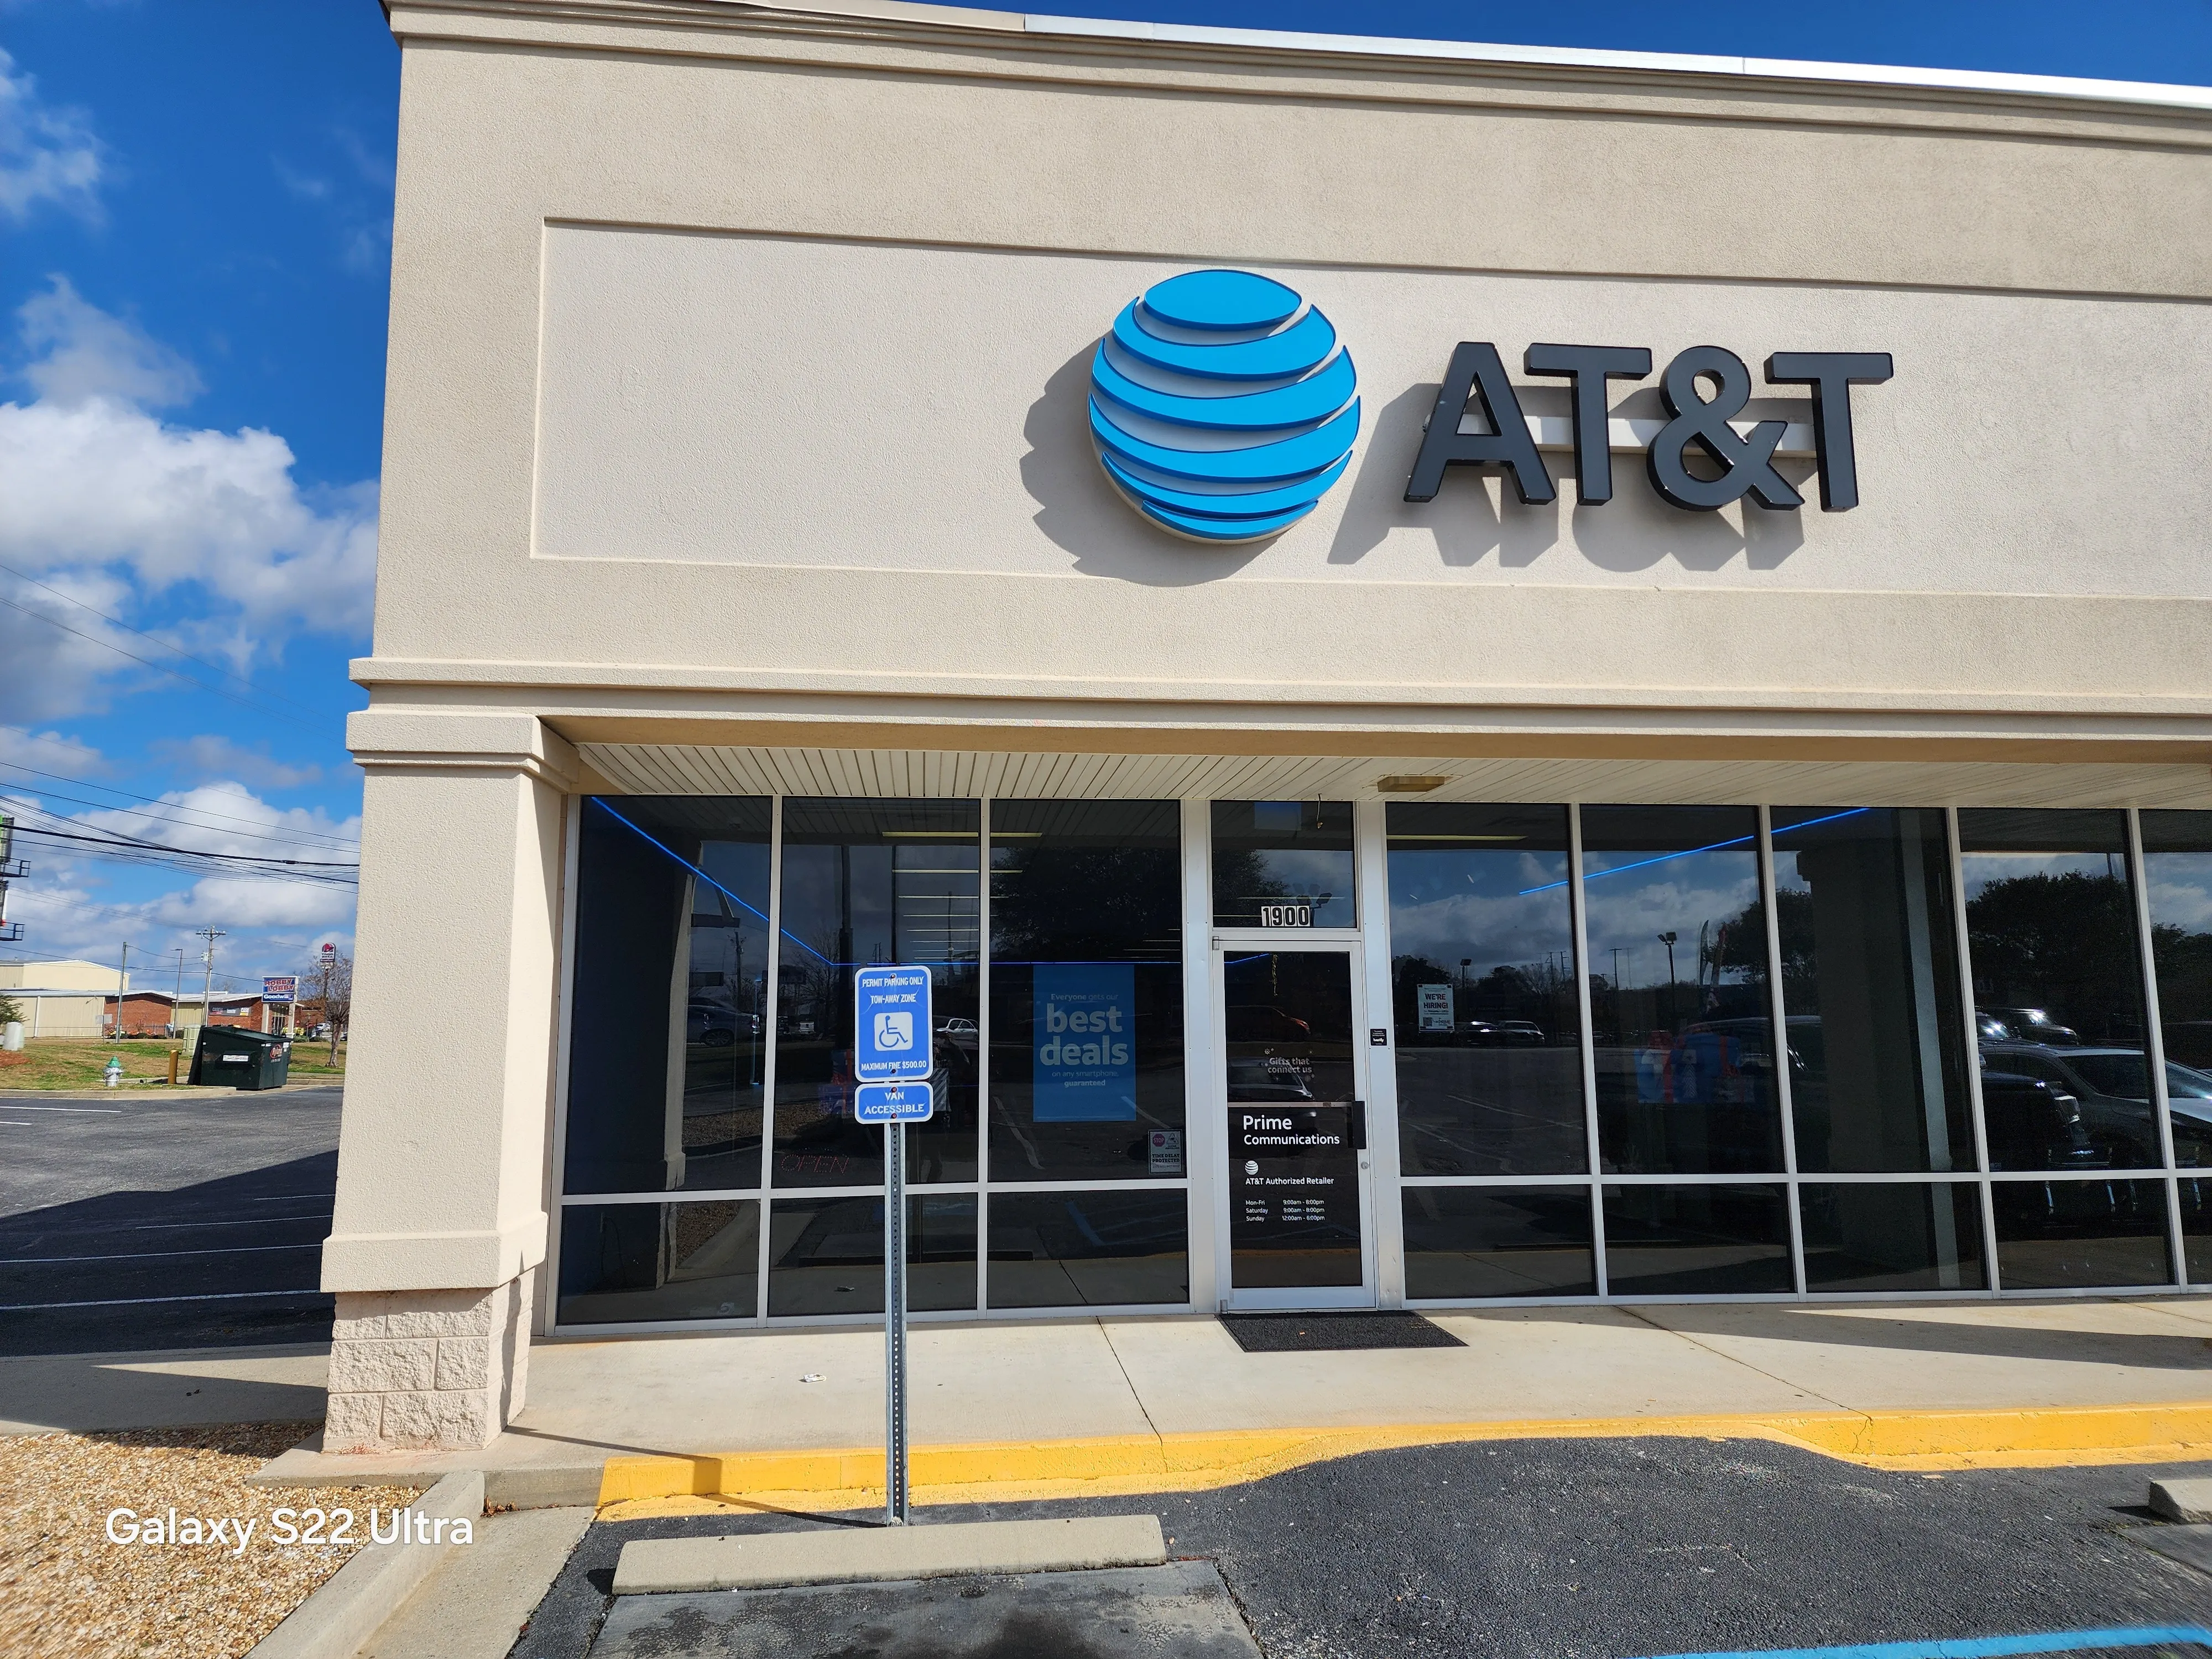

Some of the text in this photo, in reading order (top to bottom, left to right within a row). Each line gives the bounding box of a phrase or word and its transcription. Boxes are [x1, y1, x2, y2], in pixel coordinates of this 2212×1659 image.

[1404, 341, 1894, 513] AT&T
[1262, 906, 1309, 926] 1900
[862, 976, 924, 987] PERMIT PARKING ONLY
[870, 994, 916, 1004] TOW-AWAY ZONE
[1047, 1003, 1123, 1032] best
[1040, 1035, 1128, 1066] deals
[861, 1063, 888, 1071] MAXIMUM
[902, 1060, 927, 1069] $500.00
[1064, 1079, 1106, 1088] guaranteed
[885, 1092, 904, 1100] VAN
[864, 1104, 925, 1114] ACCESSIBLE
[1243, 1115, 1292, 1130] Prime
[1244, 1134, 1340, 1145] Communications
[781, 1154, 849, 1173] OPEN
